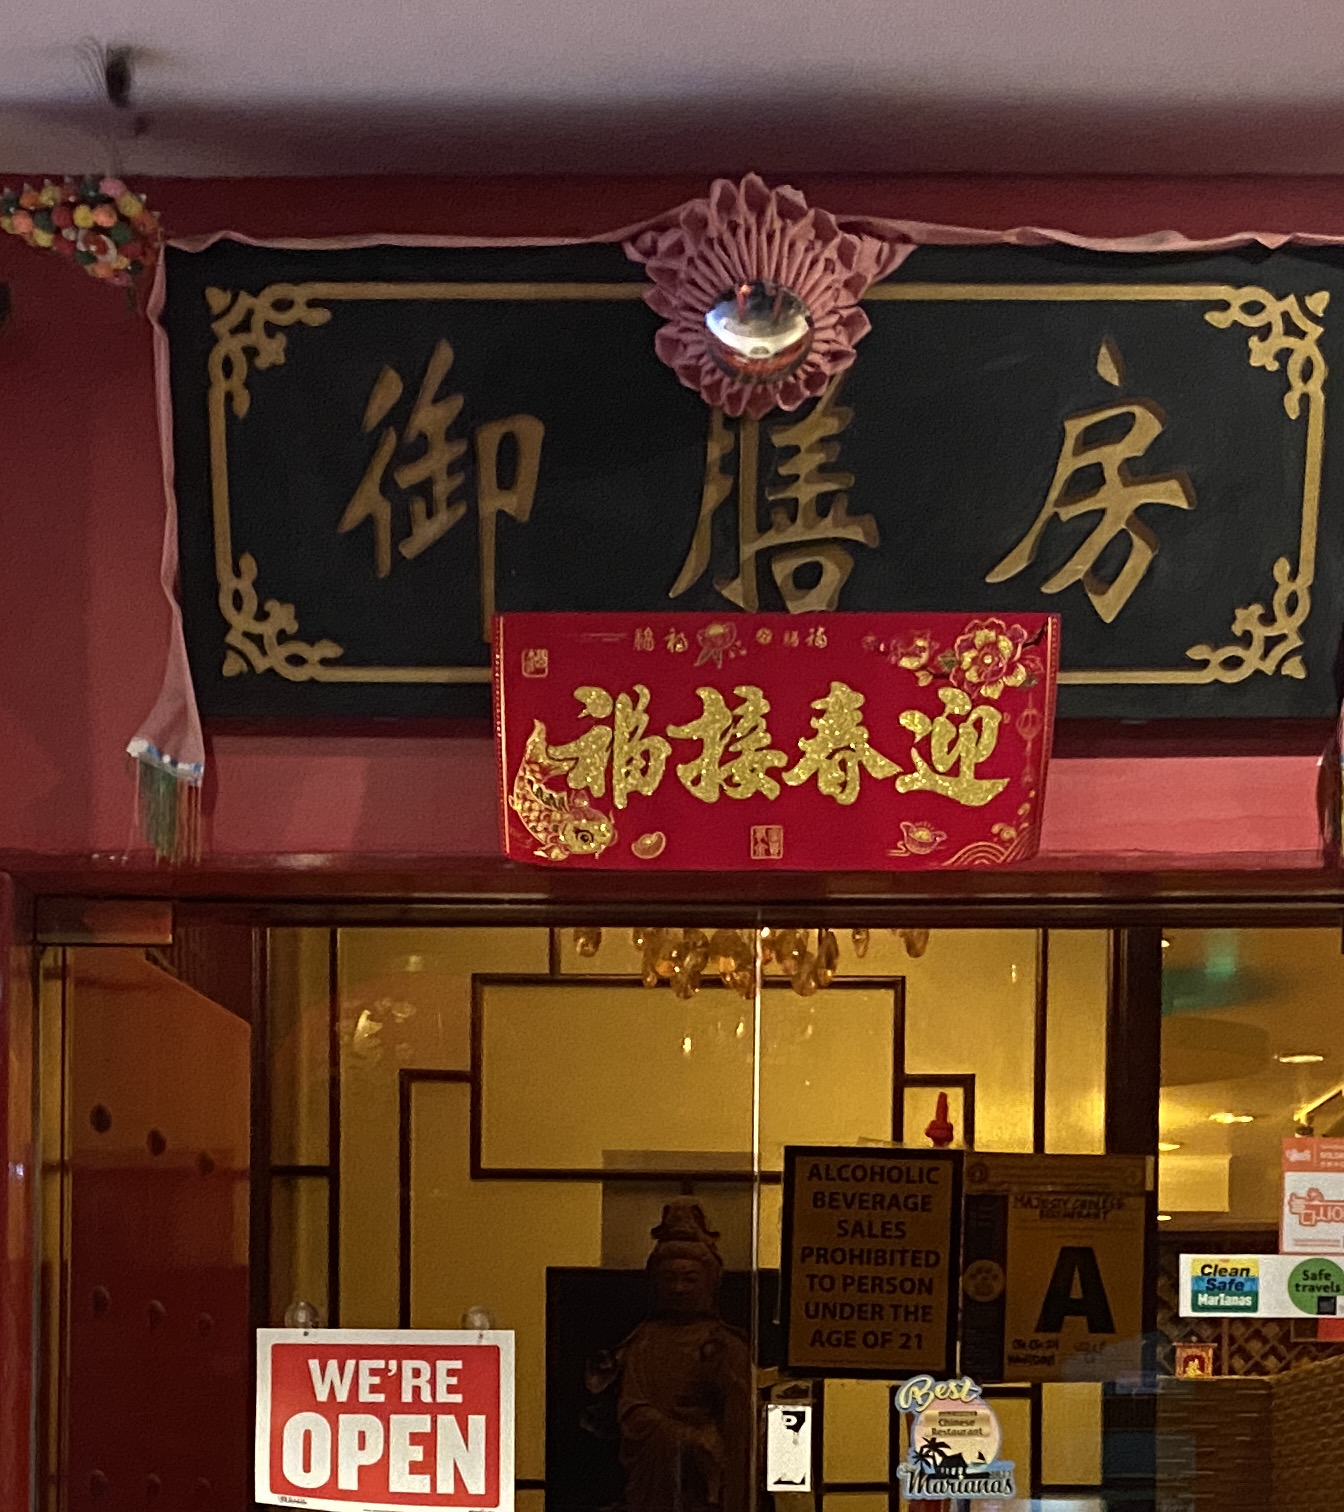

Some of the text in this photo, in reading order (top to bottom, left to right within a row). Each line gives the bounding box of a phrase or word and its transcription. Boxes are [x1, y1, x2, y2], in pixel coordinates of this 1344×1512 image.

[338, 338, 1196, 645] 御膳房
[806, 1162, 942, 1186] ALCOHOLIC
[811, 1190, 933, 1213] BEVERAGE
[836, 1218, 907, 1240] SALES
[800, 1246, 942, 1269] PROHIBITED
[1200, 1264, 1251, 1278] Clean
[1302, 1269, 1332, 1281] Safe
[806, 1273, 934, 1296] TO PERSON
[1034, 1246, 1116, 1334] A
[1205, 1278, 1245, 1292] Safe
[1295, 1281, 1342, 1293] travels
[804, 1301, 934, 1324] UNDER THE
[809, 1329, 924, 1350] AGE OF 21
[898, 1376, 979, 1413] Best
[931, 1427, 984, 1437] Restaurant
[282, 1411, 487, 1495] OPEN
[906, 1469, 1014, 1495] Marianas
